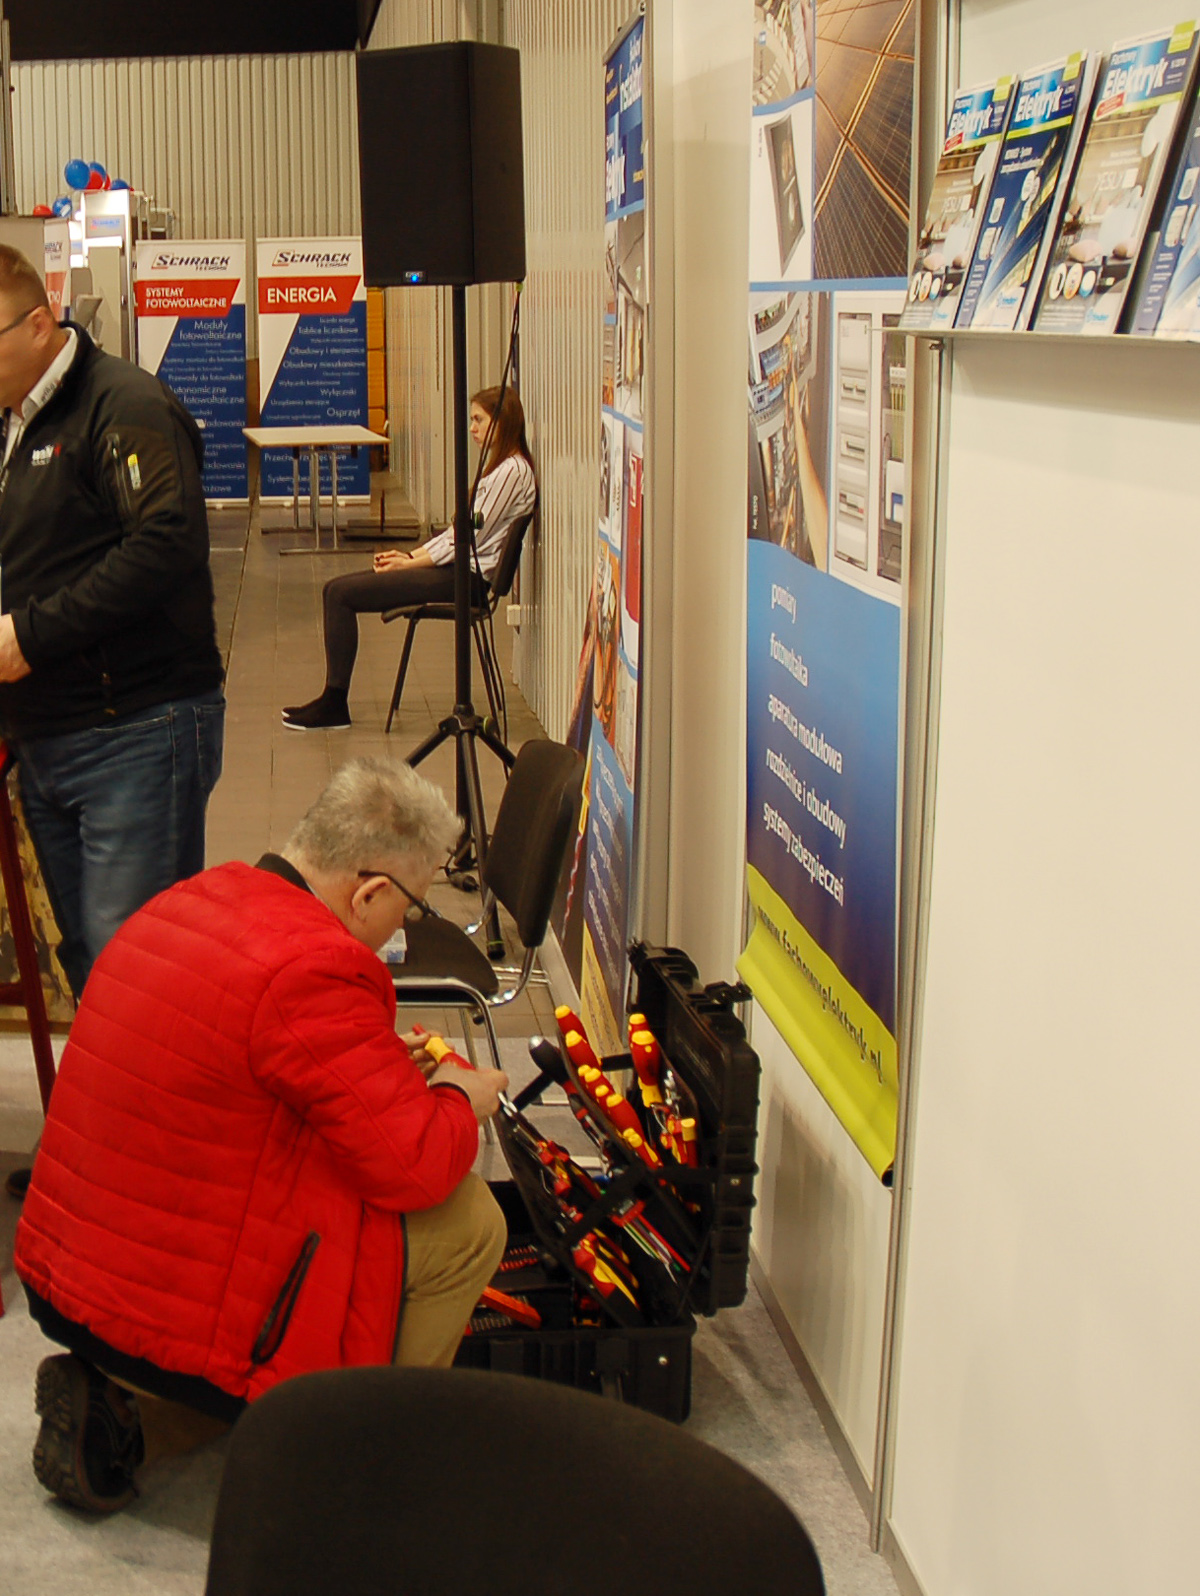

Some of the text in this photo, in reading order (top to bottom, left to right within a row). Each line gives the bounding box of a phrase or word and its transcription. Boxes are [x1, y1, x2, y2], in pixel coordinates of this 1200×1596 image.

[1102, 57, 1169, 100] Elektryk
[948, 104, 993, 137] Elektryk
[1014, 85, 1064, 123] Elektryk
[156, 254, 230, 266] SCHRACK
[277, 251, 352, 263] SCHRACK
[145, 287, 184, 298] SYSTEMY
[145, 297, 227, 309] FOTOWOLTAICZNE
[267, 286, 337, 303] ENERGIA
[771, 583, 797, 624] pomiary
[768, 693, 843, 775] aparatura modułowa
[765, 747, 802, 803] rozdzielnice
[806, 787, 847, 850] obudowy
[763, 801, 844, 907] systemy zabezpieczeń
